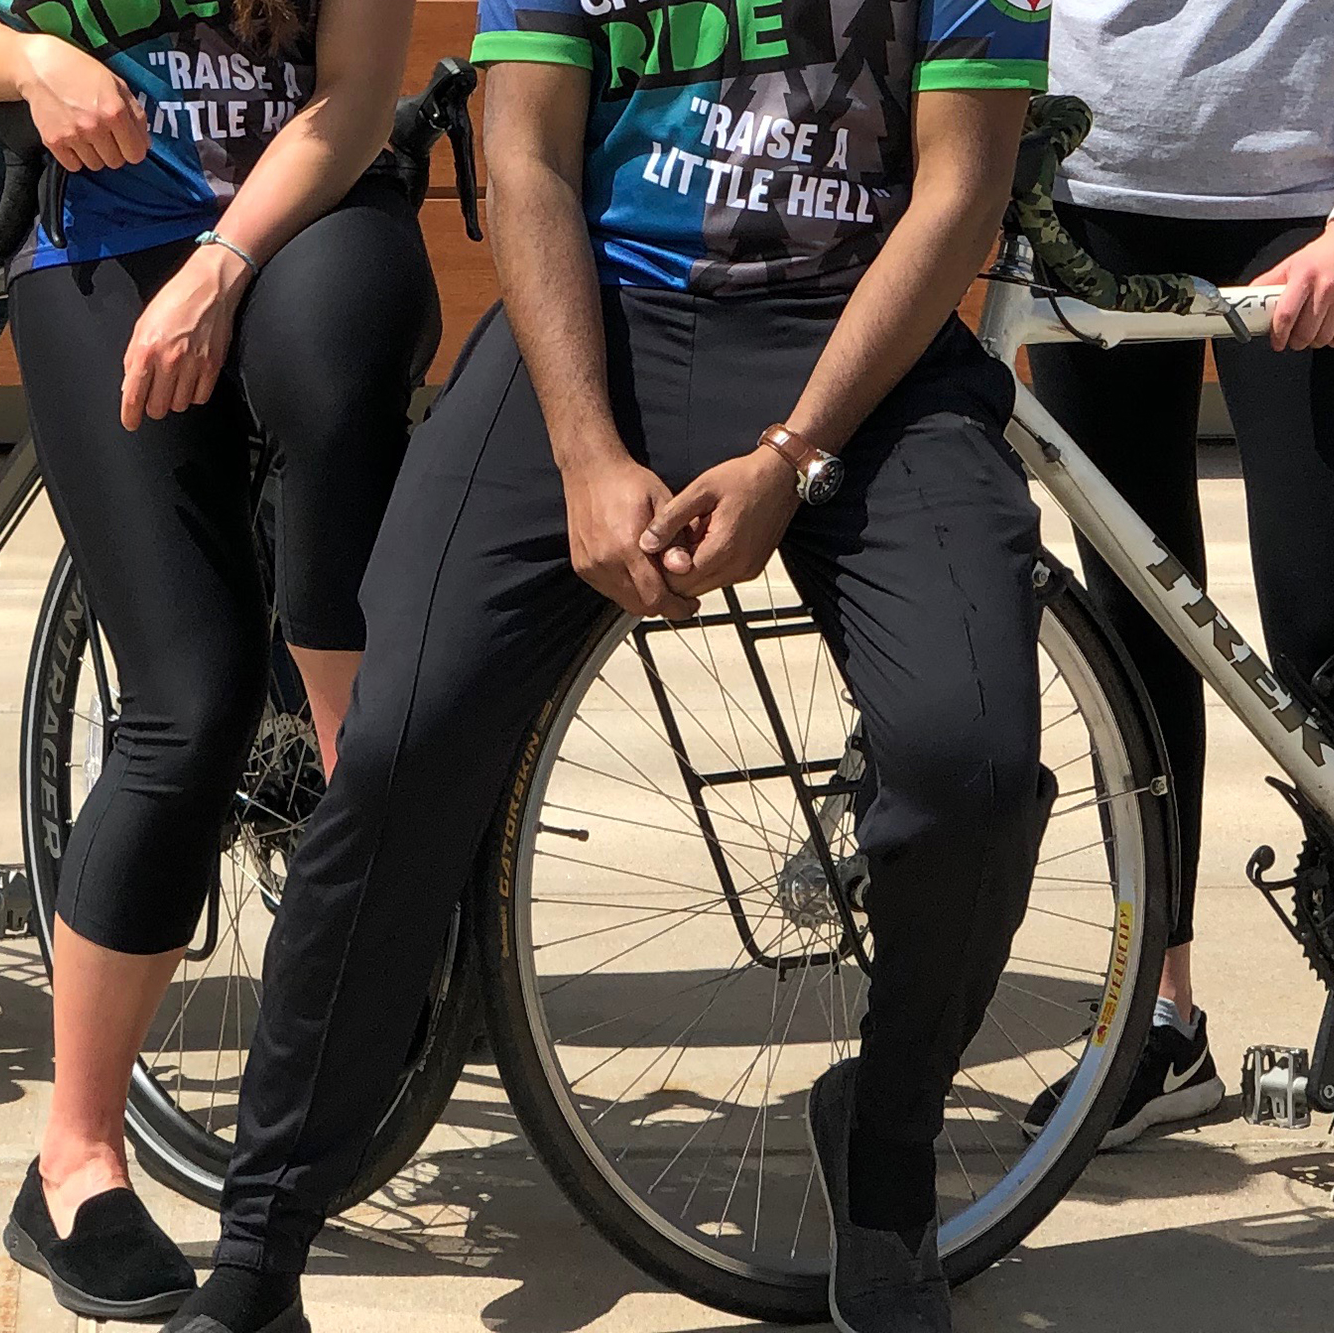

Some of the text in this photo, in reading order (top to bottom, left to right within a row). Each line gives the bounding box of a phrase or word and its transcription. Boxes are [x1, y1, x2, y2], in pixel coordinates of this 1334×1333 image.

[148, 51, 302, 99] "RAISE A
[690, 96, 849, 170] "RAISE A
[642, 141, 891, 223] LITTLE HELL"
[41, 578, 85, 859] NTRAGER
[499, 732, 539, 899] GATORSKIN
[1109, 910, 1130, 1001] VELOCITY
